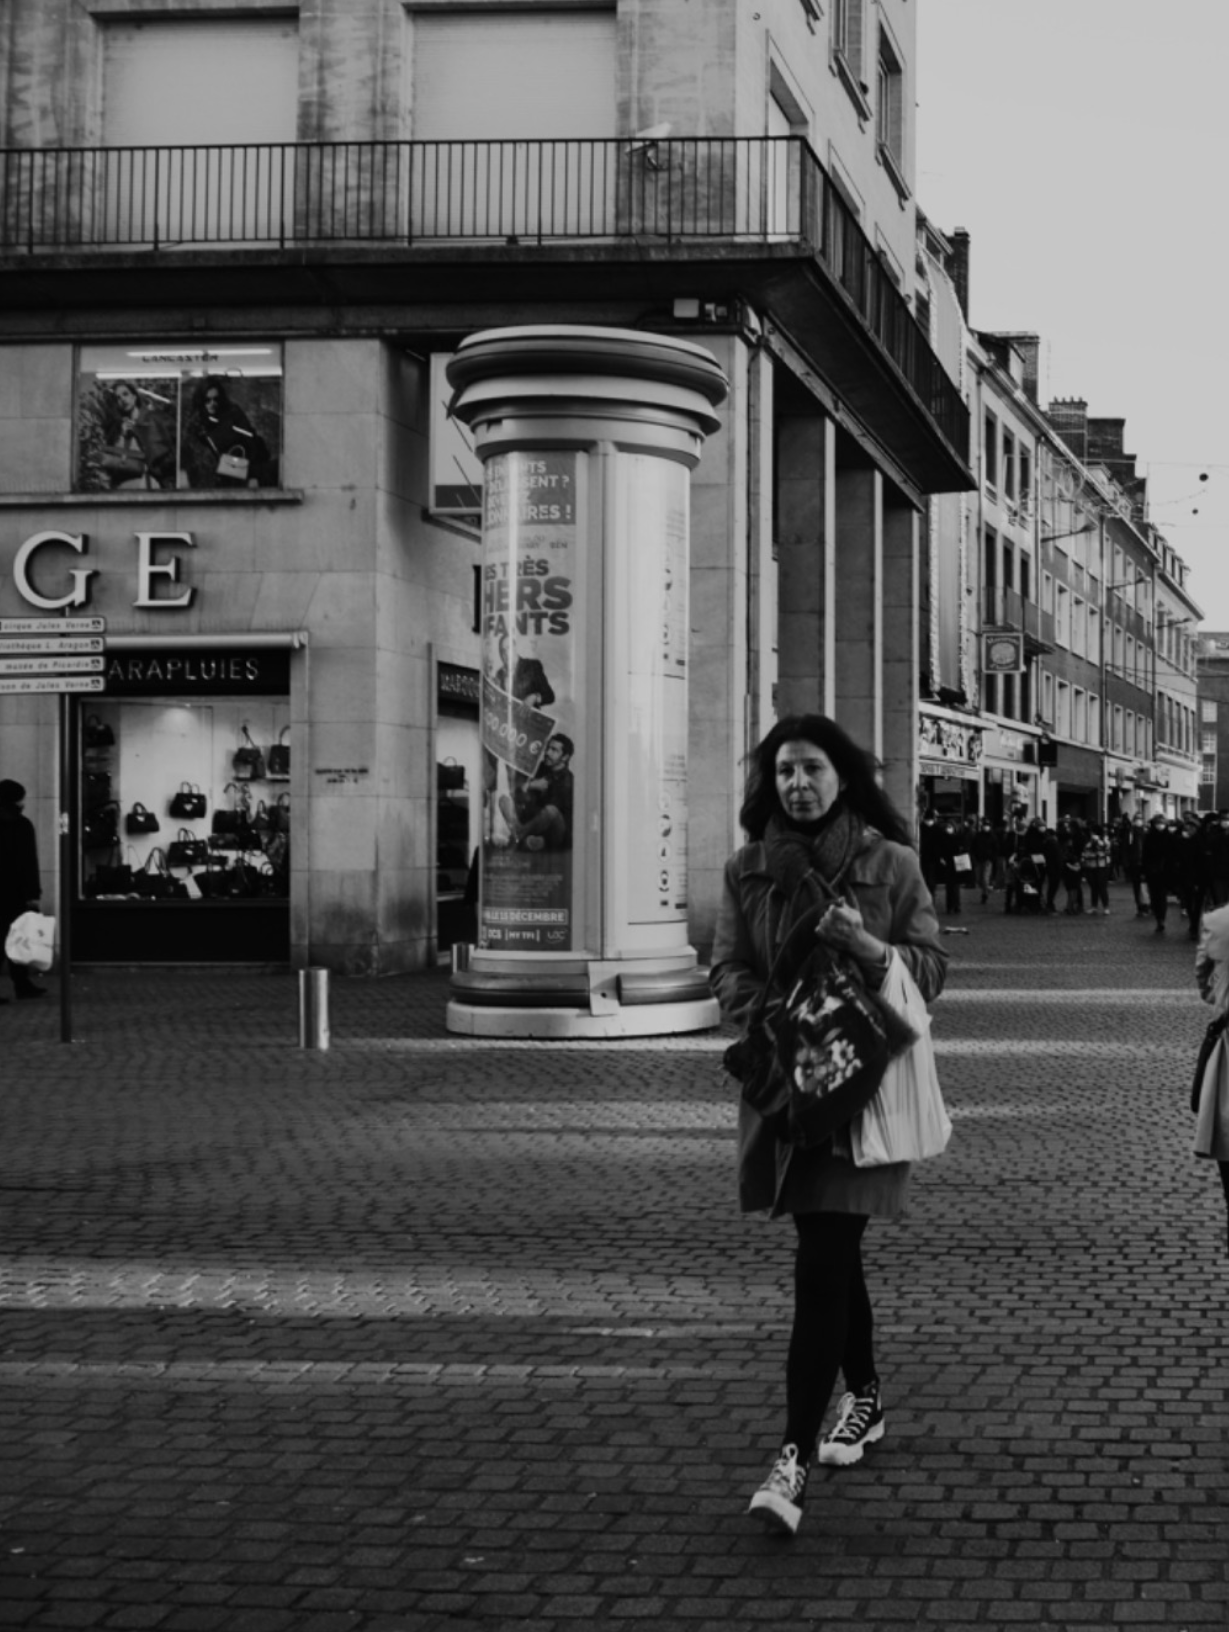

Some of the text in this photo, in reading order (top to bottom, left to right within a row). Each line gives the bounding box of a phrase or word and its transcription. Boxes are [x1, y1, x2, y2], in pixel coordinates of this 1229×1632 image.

[36, 621, 60, 629] Jules
[65, 620, 90, 629] Verne
[36, 680, 60, 690] Jules
[65, 679, 90, 689] Verne
